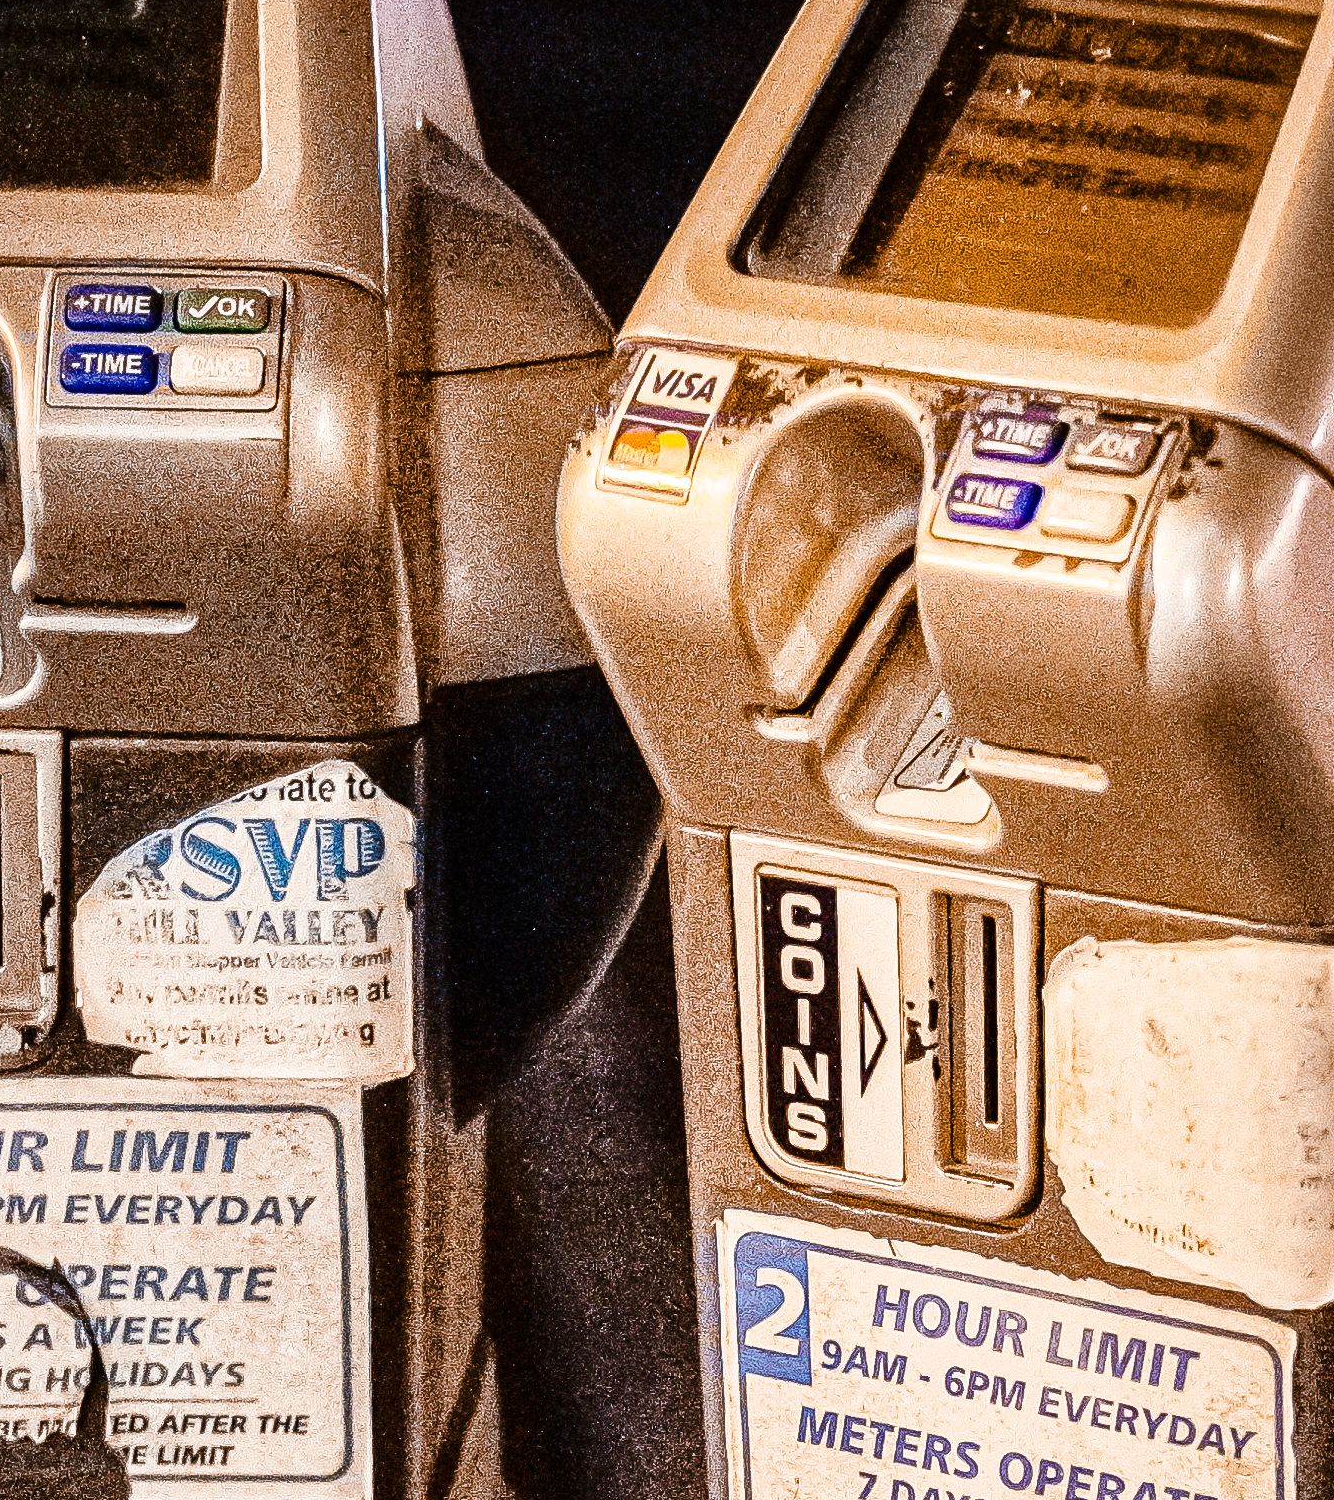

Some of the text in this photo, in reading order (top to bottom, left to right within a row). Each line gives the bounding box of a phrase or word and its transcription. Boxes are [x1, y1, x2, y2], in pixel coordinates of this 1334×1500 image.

[652, 369, 718, 403] VISA
[224, 906, 386, 947] VALLEY
[779, 891, 831, 1152] COINS
[70, 1129, 252, 1174] LIMIT
[62, 1194, 317, 1227] EVERYDAY
[744, 1267, 1201, 1393] 2 HOUR LIMIT
[821, 1339, 908, 1386] 9AM
[944, 1365, 1027, 1411] 6PM
[1037, 1385, 1258, 1460] EVERYDAY
[156, 1414, 248, 1436] AFTER
[257, 1414, 310, 1436] THE
[796, 1405, 981, 1480] METERS
[156, 1444, 235, 1467] LIMIT
[857, 1471, 878, 1500] 7
